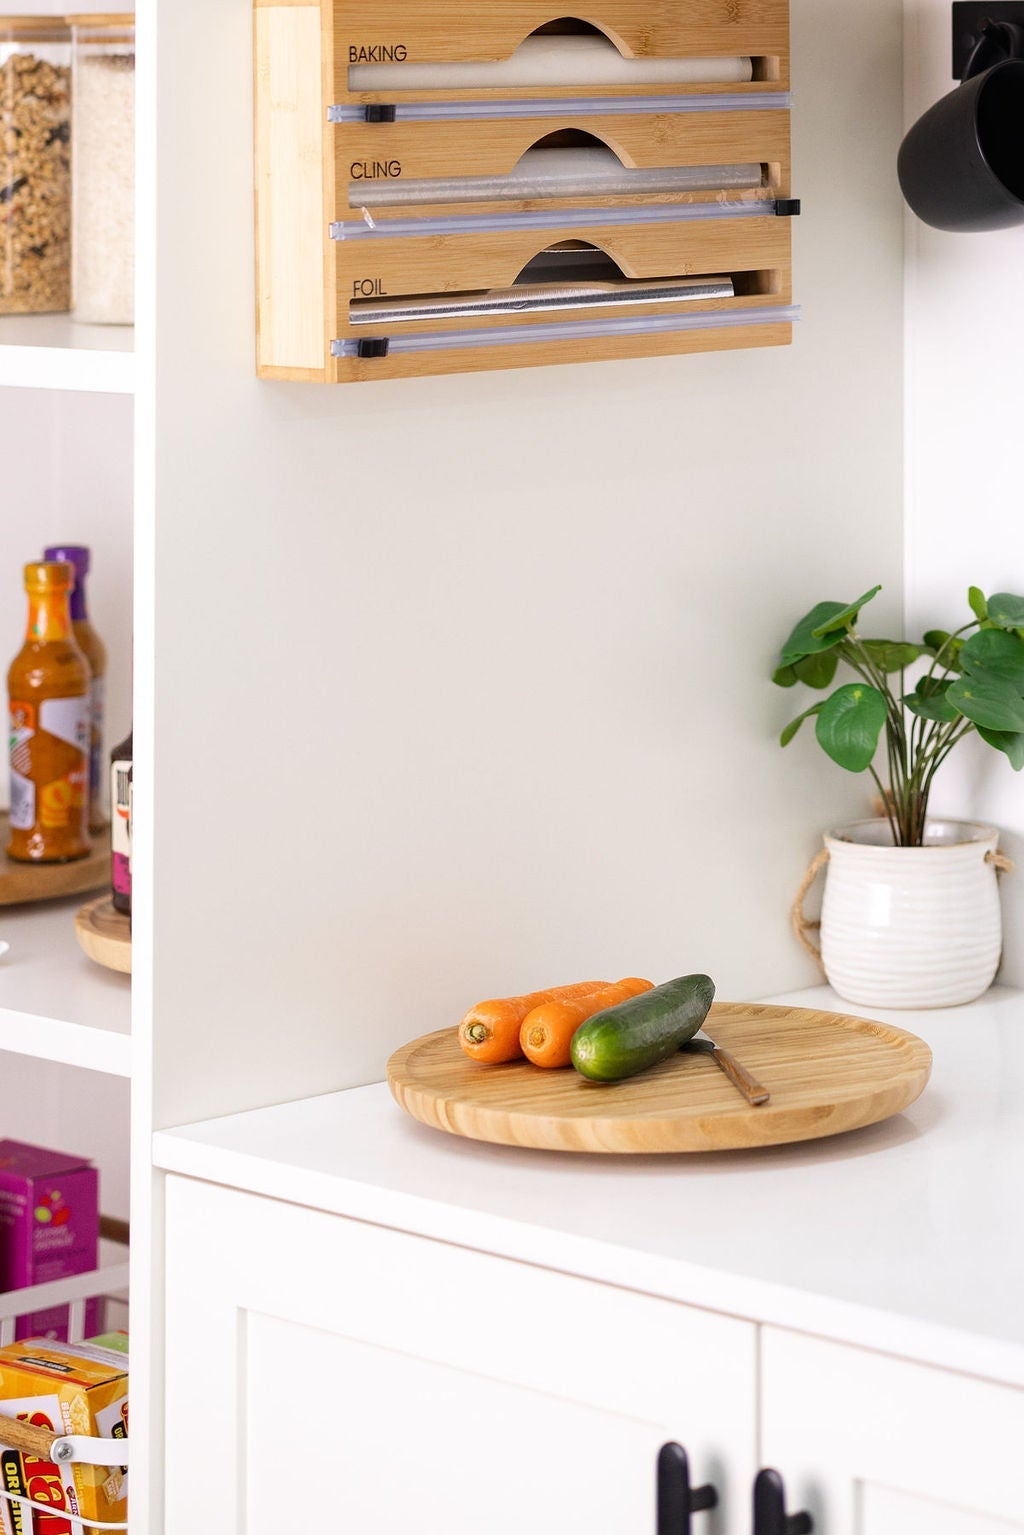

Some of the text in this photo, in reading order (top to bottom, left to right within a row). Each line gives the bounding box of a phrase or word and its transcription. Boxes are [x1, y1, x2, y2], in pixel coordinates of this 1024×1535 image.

[349, 45, 407, 63] BAKING
[350, 160, 402, 179] CLING
[353, 278, 387, 297] FOIL
